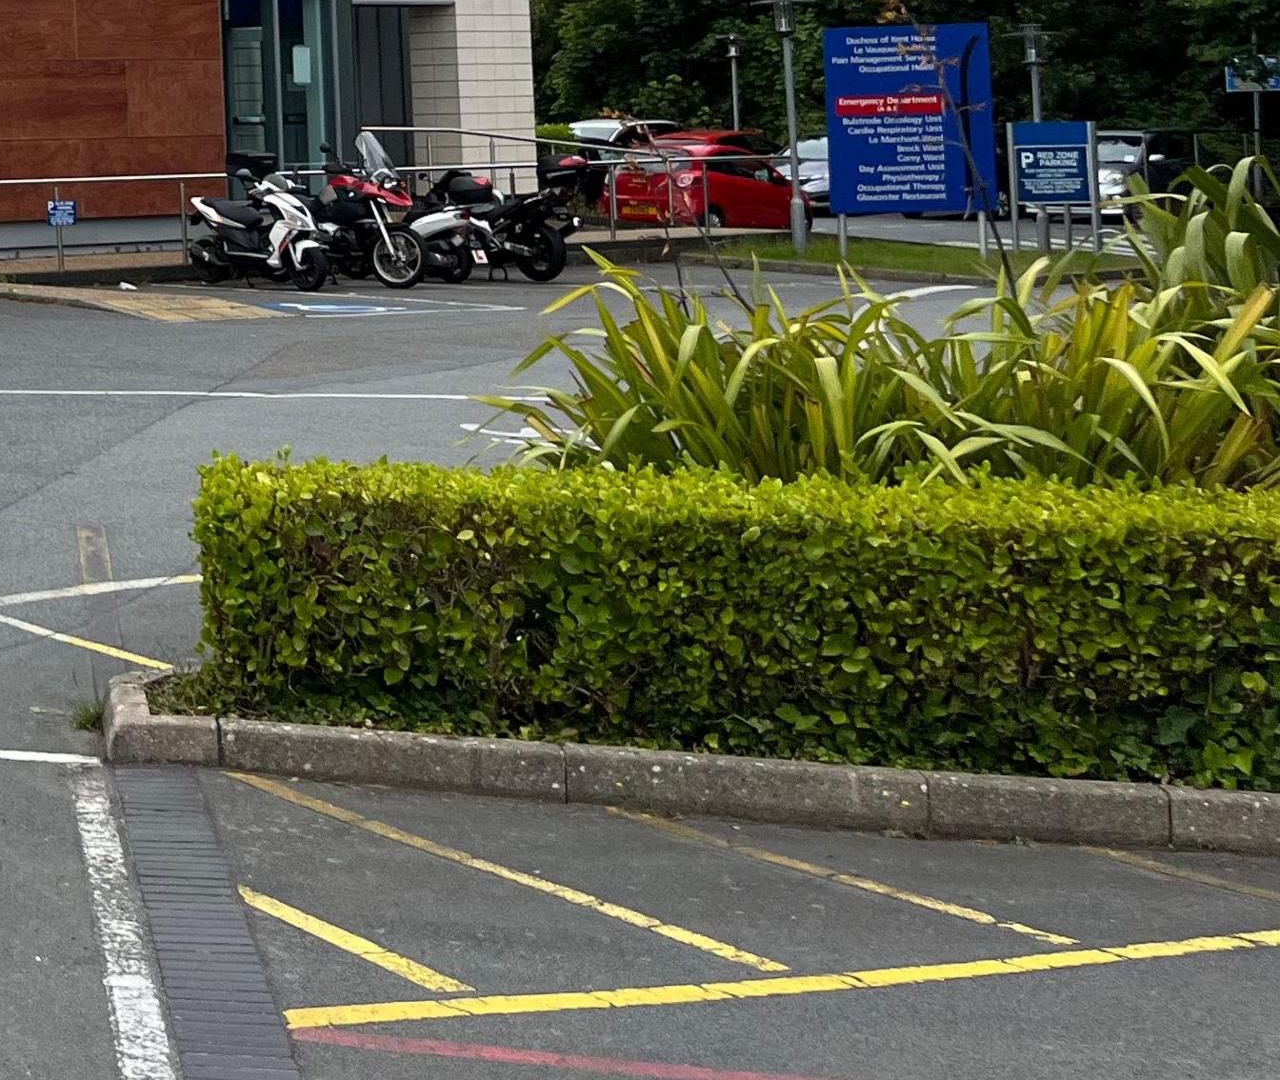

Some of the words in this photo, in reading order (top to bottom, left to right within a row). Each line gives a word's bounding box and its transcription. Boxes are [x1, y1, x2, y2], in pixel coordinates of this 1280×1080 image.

[846, 36, 878, 45] Duchess
[880, 35, 889, 44] of
[854, 46, 863, 54] Le
[850, 55, 902, 65] Management
[859, 64, 909, 73] Occupational
[839, 98, 884, 107] Emergency
[886, 96, 937, 104] Deartment
[842, 117, 882, 126] Bulstrode
[883, 116, 923, 125] Oncology
[925, 114, 942, 123] Unit
[847, 127, 875, 135] Cardio
[877, 126, 923, 135] Respiratory
[868, 136, 878, 144] Le
[880, 135, 920, 144] Marchant
[921, 134, 944, 142] Ward
[922, 144, 944, 152] Ward
[922, 153, 945, 161] Ward
[1021, 151, 1034, 169] P
[1056, 151, 1079, 159] ZONE
[1040, 159, 1077, 167] PARKING
[858, 165, 875, 174] Day
[877, 164, 926, 172] Assessment
[882, 173, 940, 183] Physiotherapy
[857, 183, 910, 192] Occupational
[912, 182, 946, 191] Therapy
[902, 192, 947, 200] Restaurant
